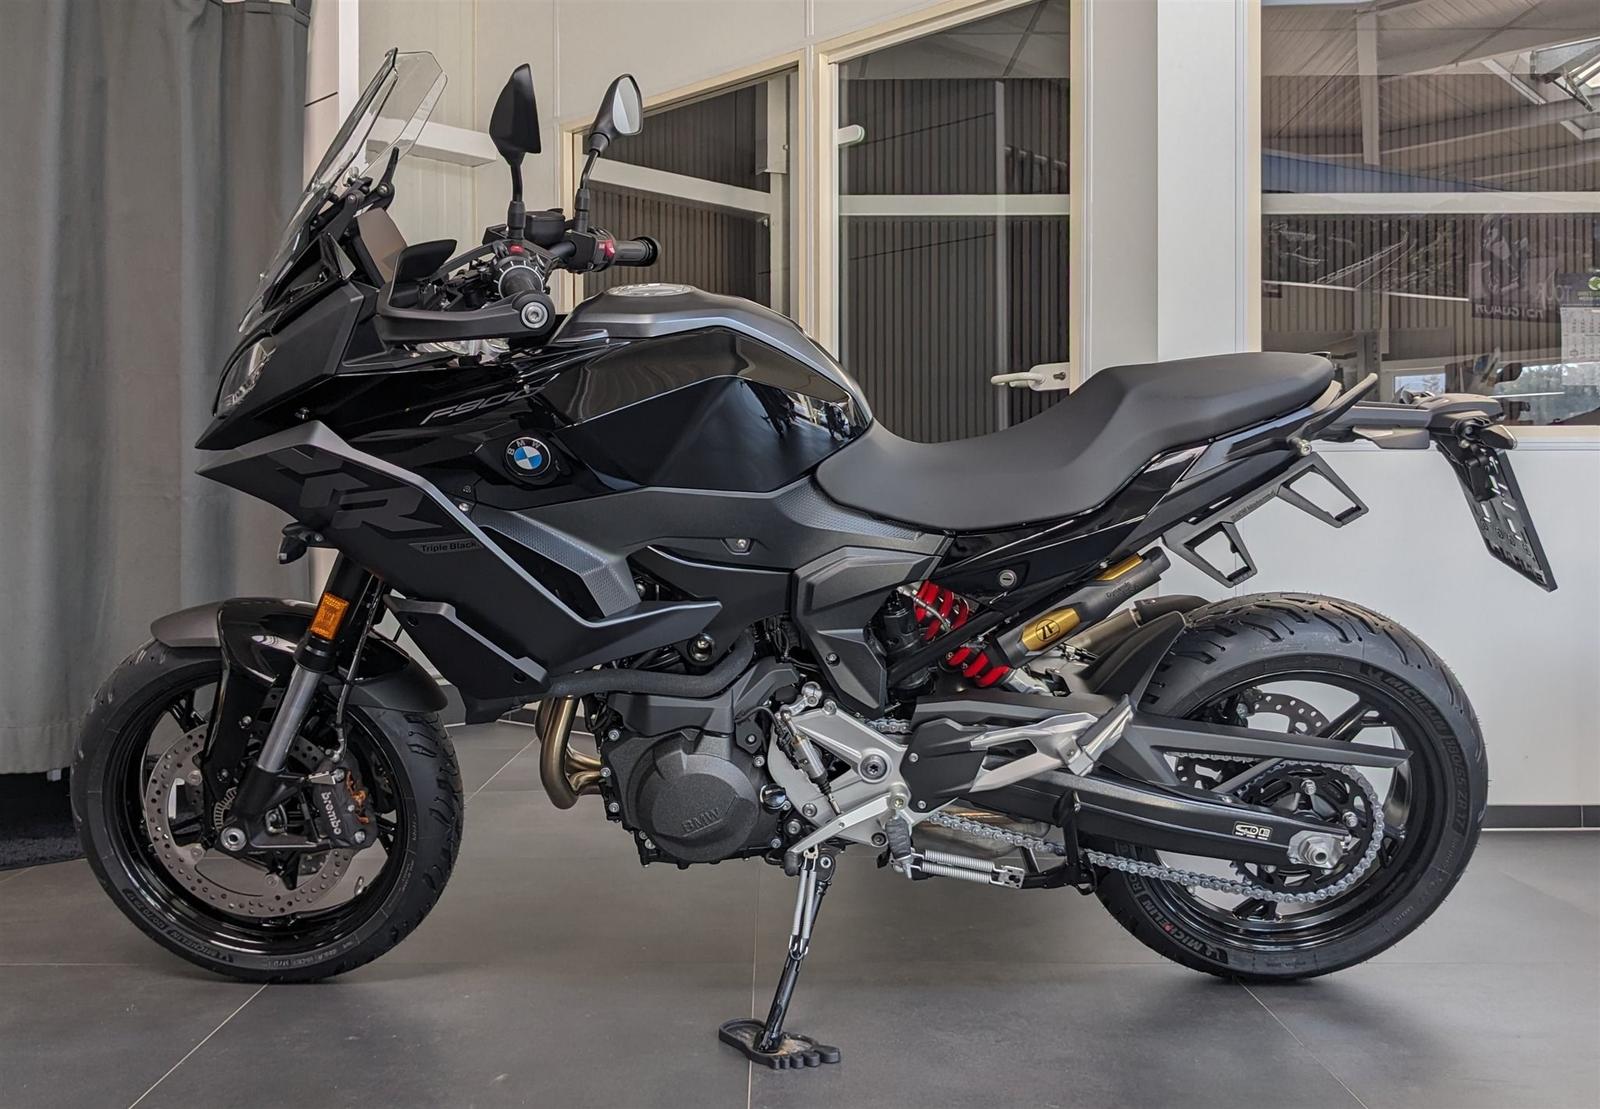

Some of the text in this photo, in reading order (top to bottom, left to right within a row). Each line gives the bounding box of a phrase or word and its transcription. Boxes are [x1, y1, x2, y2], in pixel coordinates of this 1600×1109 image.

[422, 541, 477, 553] Triple Black
[1037, 620, 1060, 641] ZF
[1385, 675, 1450, 737] MICHELIN
[321, 791, 342, 835] brembo
[681, 807, 720, 833] BMW
[1141, 895, 1204, 951] MICHELIN
